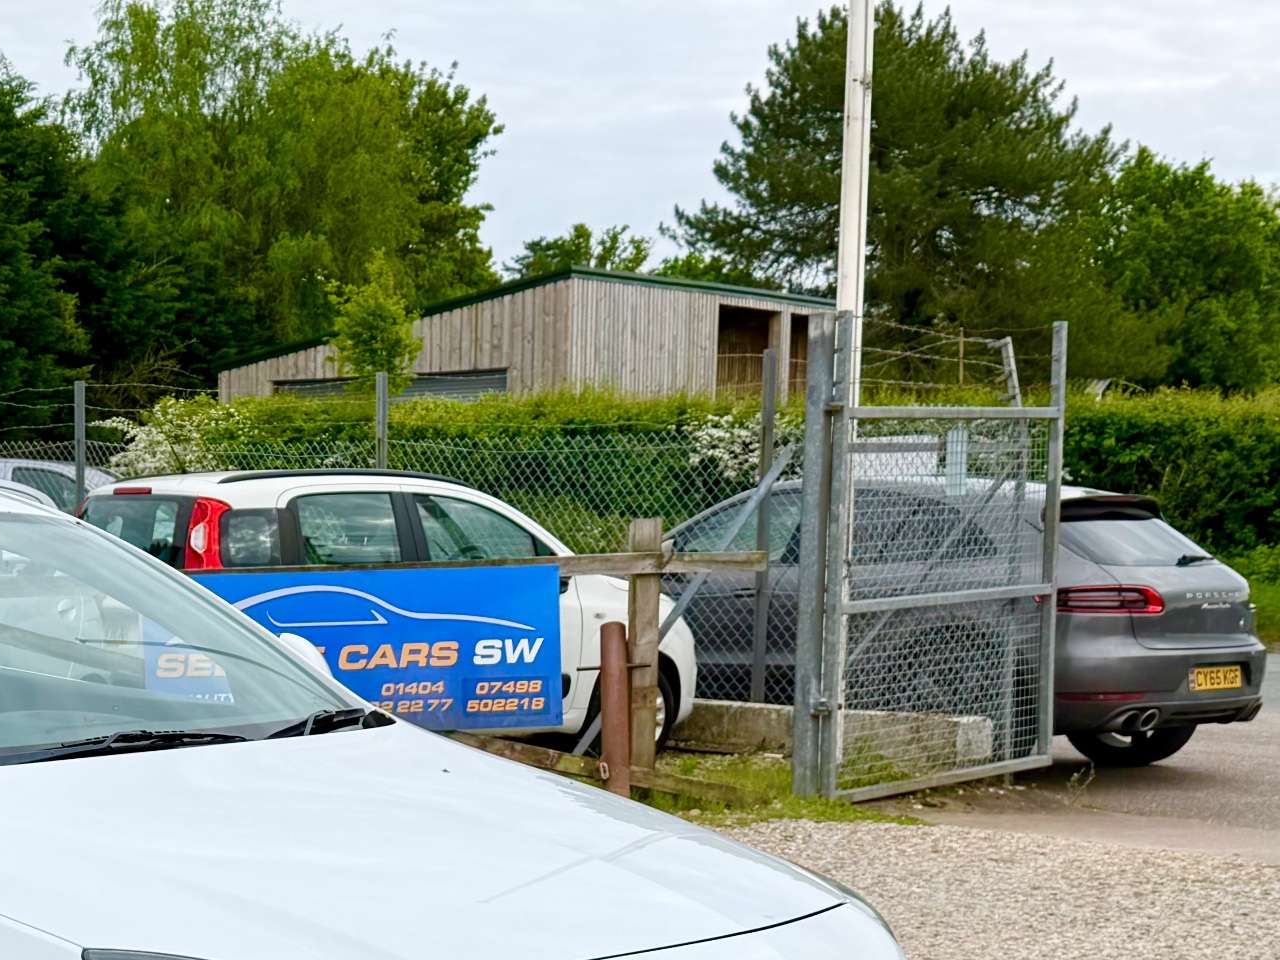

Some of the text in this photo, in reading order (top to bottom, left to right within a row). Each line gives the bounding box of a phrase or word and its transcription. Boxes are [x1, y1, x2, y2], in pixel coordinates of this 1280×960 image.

[338, 641, 460, 671] CARS
[473, 637, 544, 666] SW
[1196, 669, 1222, 687] CY65
[381, 681, 445, 696] 01404
[476, 680, 542, 695] 07498
[396, 700, 423, 713] 22
[427, 698, 454, 712] 77
[466, 697, 545, 712] 502218
